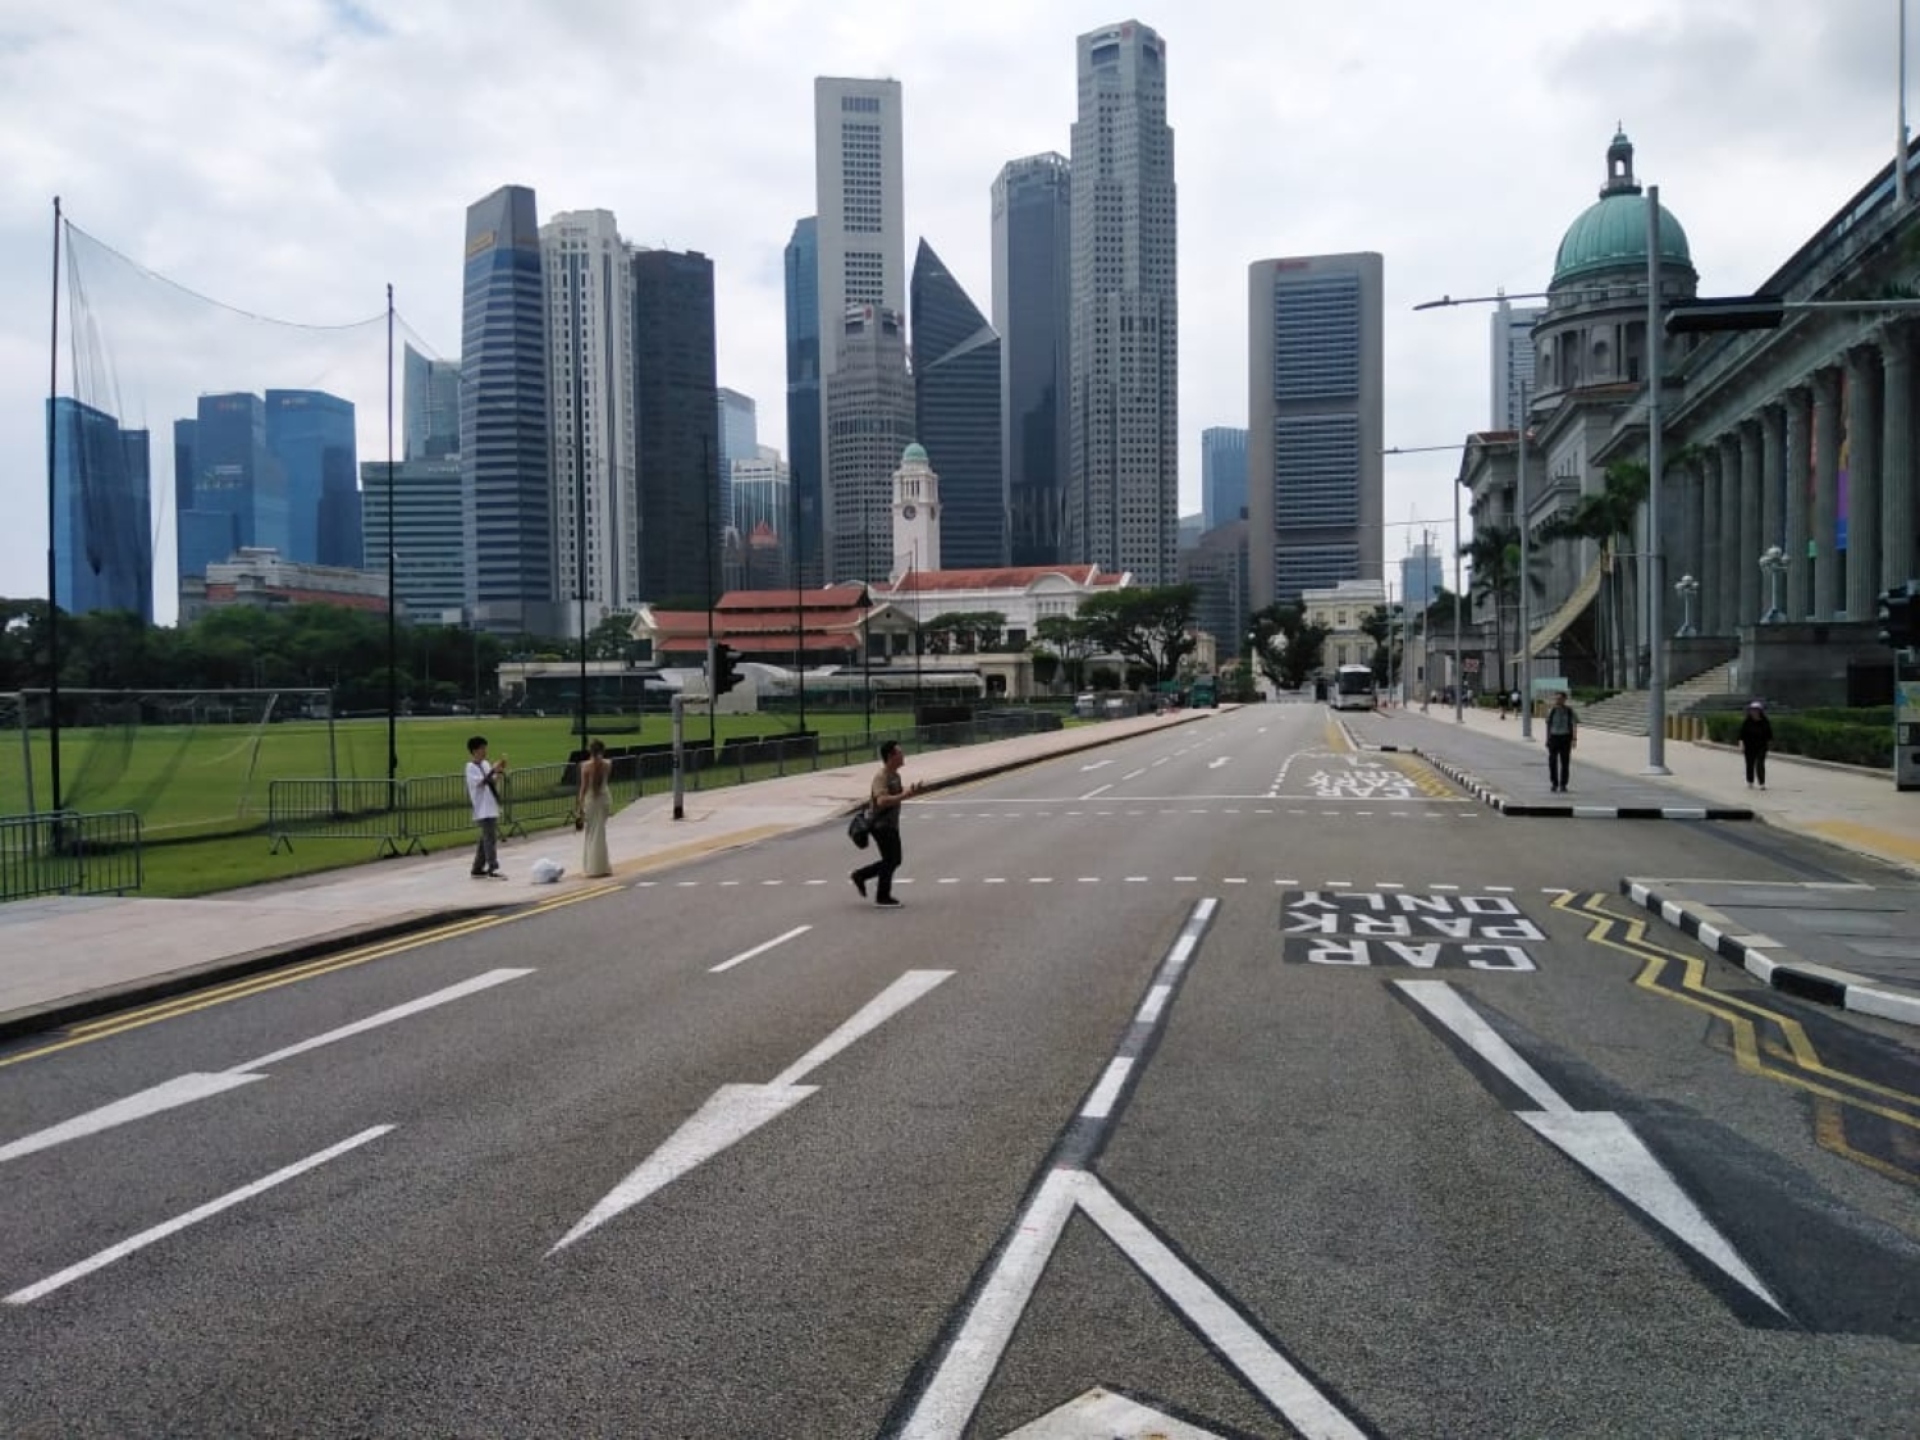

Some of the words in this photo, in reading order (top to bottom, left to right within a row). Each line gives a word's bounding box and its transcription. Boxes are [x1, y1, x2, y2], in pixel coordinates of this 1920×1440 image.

[1304, 777, 1416, 787] PARK
[1316, 786, 1410, 798] CAR
[1287, 892, 1520, 915] ONLY
[1284, 912, 1546, 941] PARK
[1308, 939, 1537, 971] CAR
